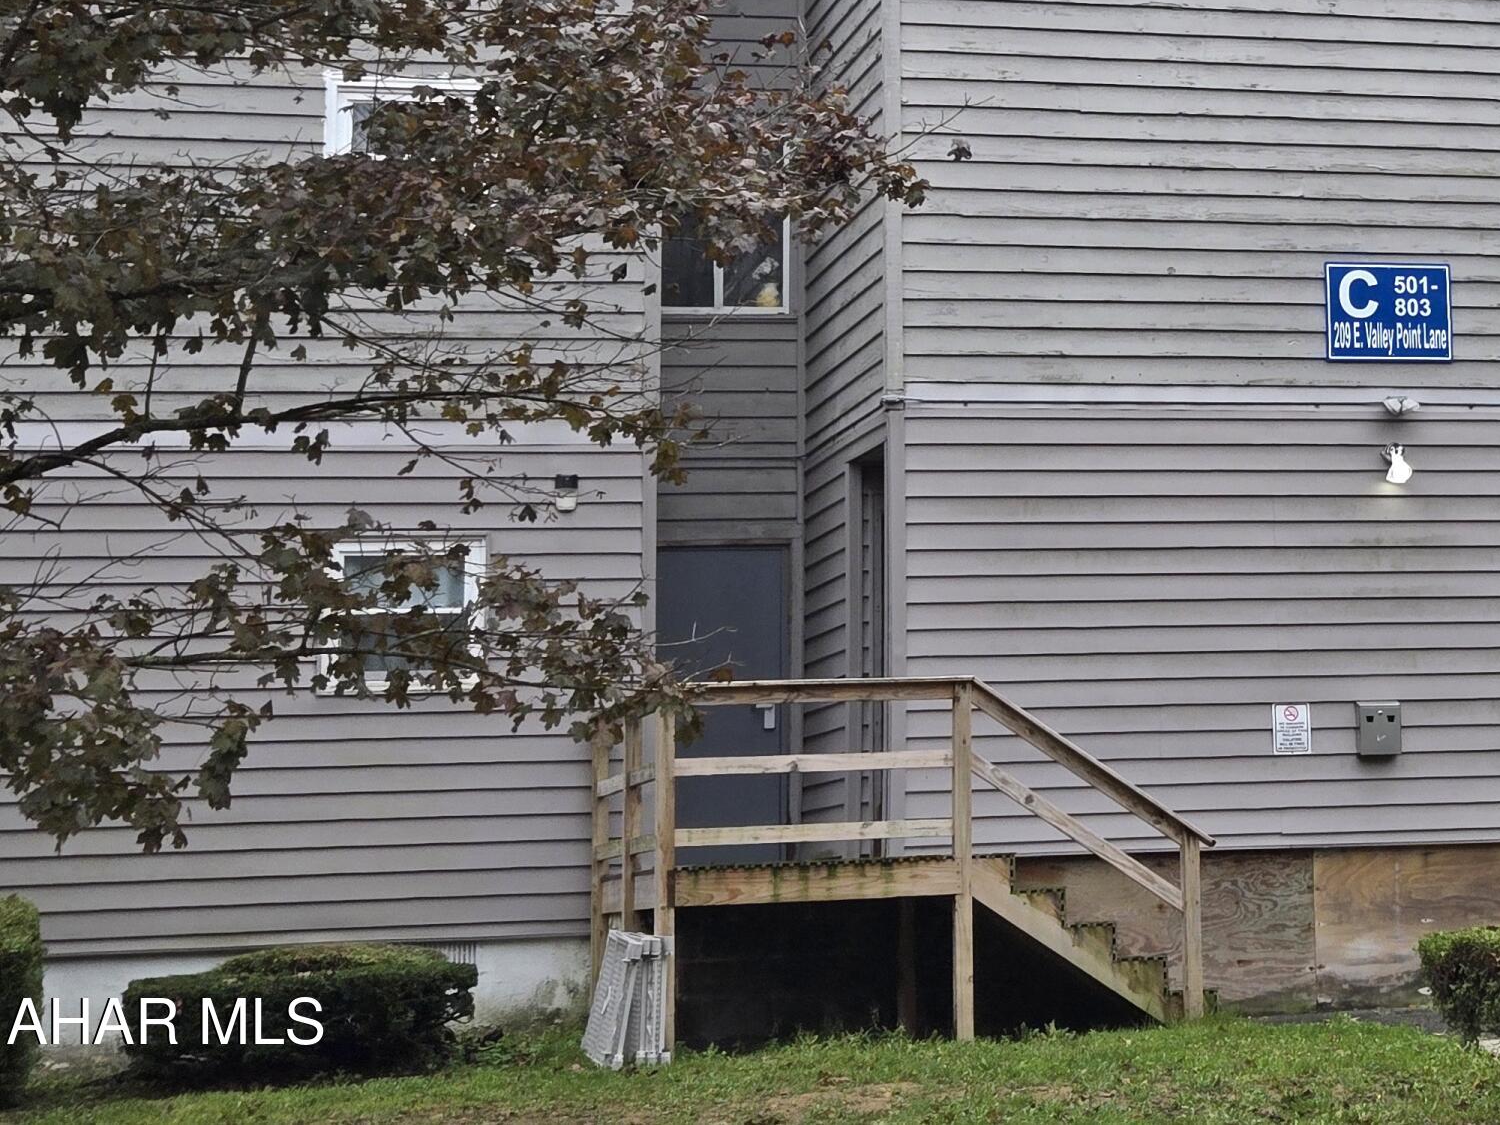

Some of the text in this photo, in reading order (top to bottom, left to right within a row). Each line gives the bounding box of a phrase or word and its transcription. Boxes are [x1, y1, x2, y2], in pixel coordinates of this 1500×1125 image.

[1339, 270, 1379, 319] C
[1394, 276, 1438, 294] 501-
[1394, 298, 1431, 317] 803
[1333, 321, 1447, 356] 209 E. Valley Point Lane
